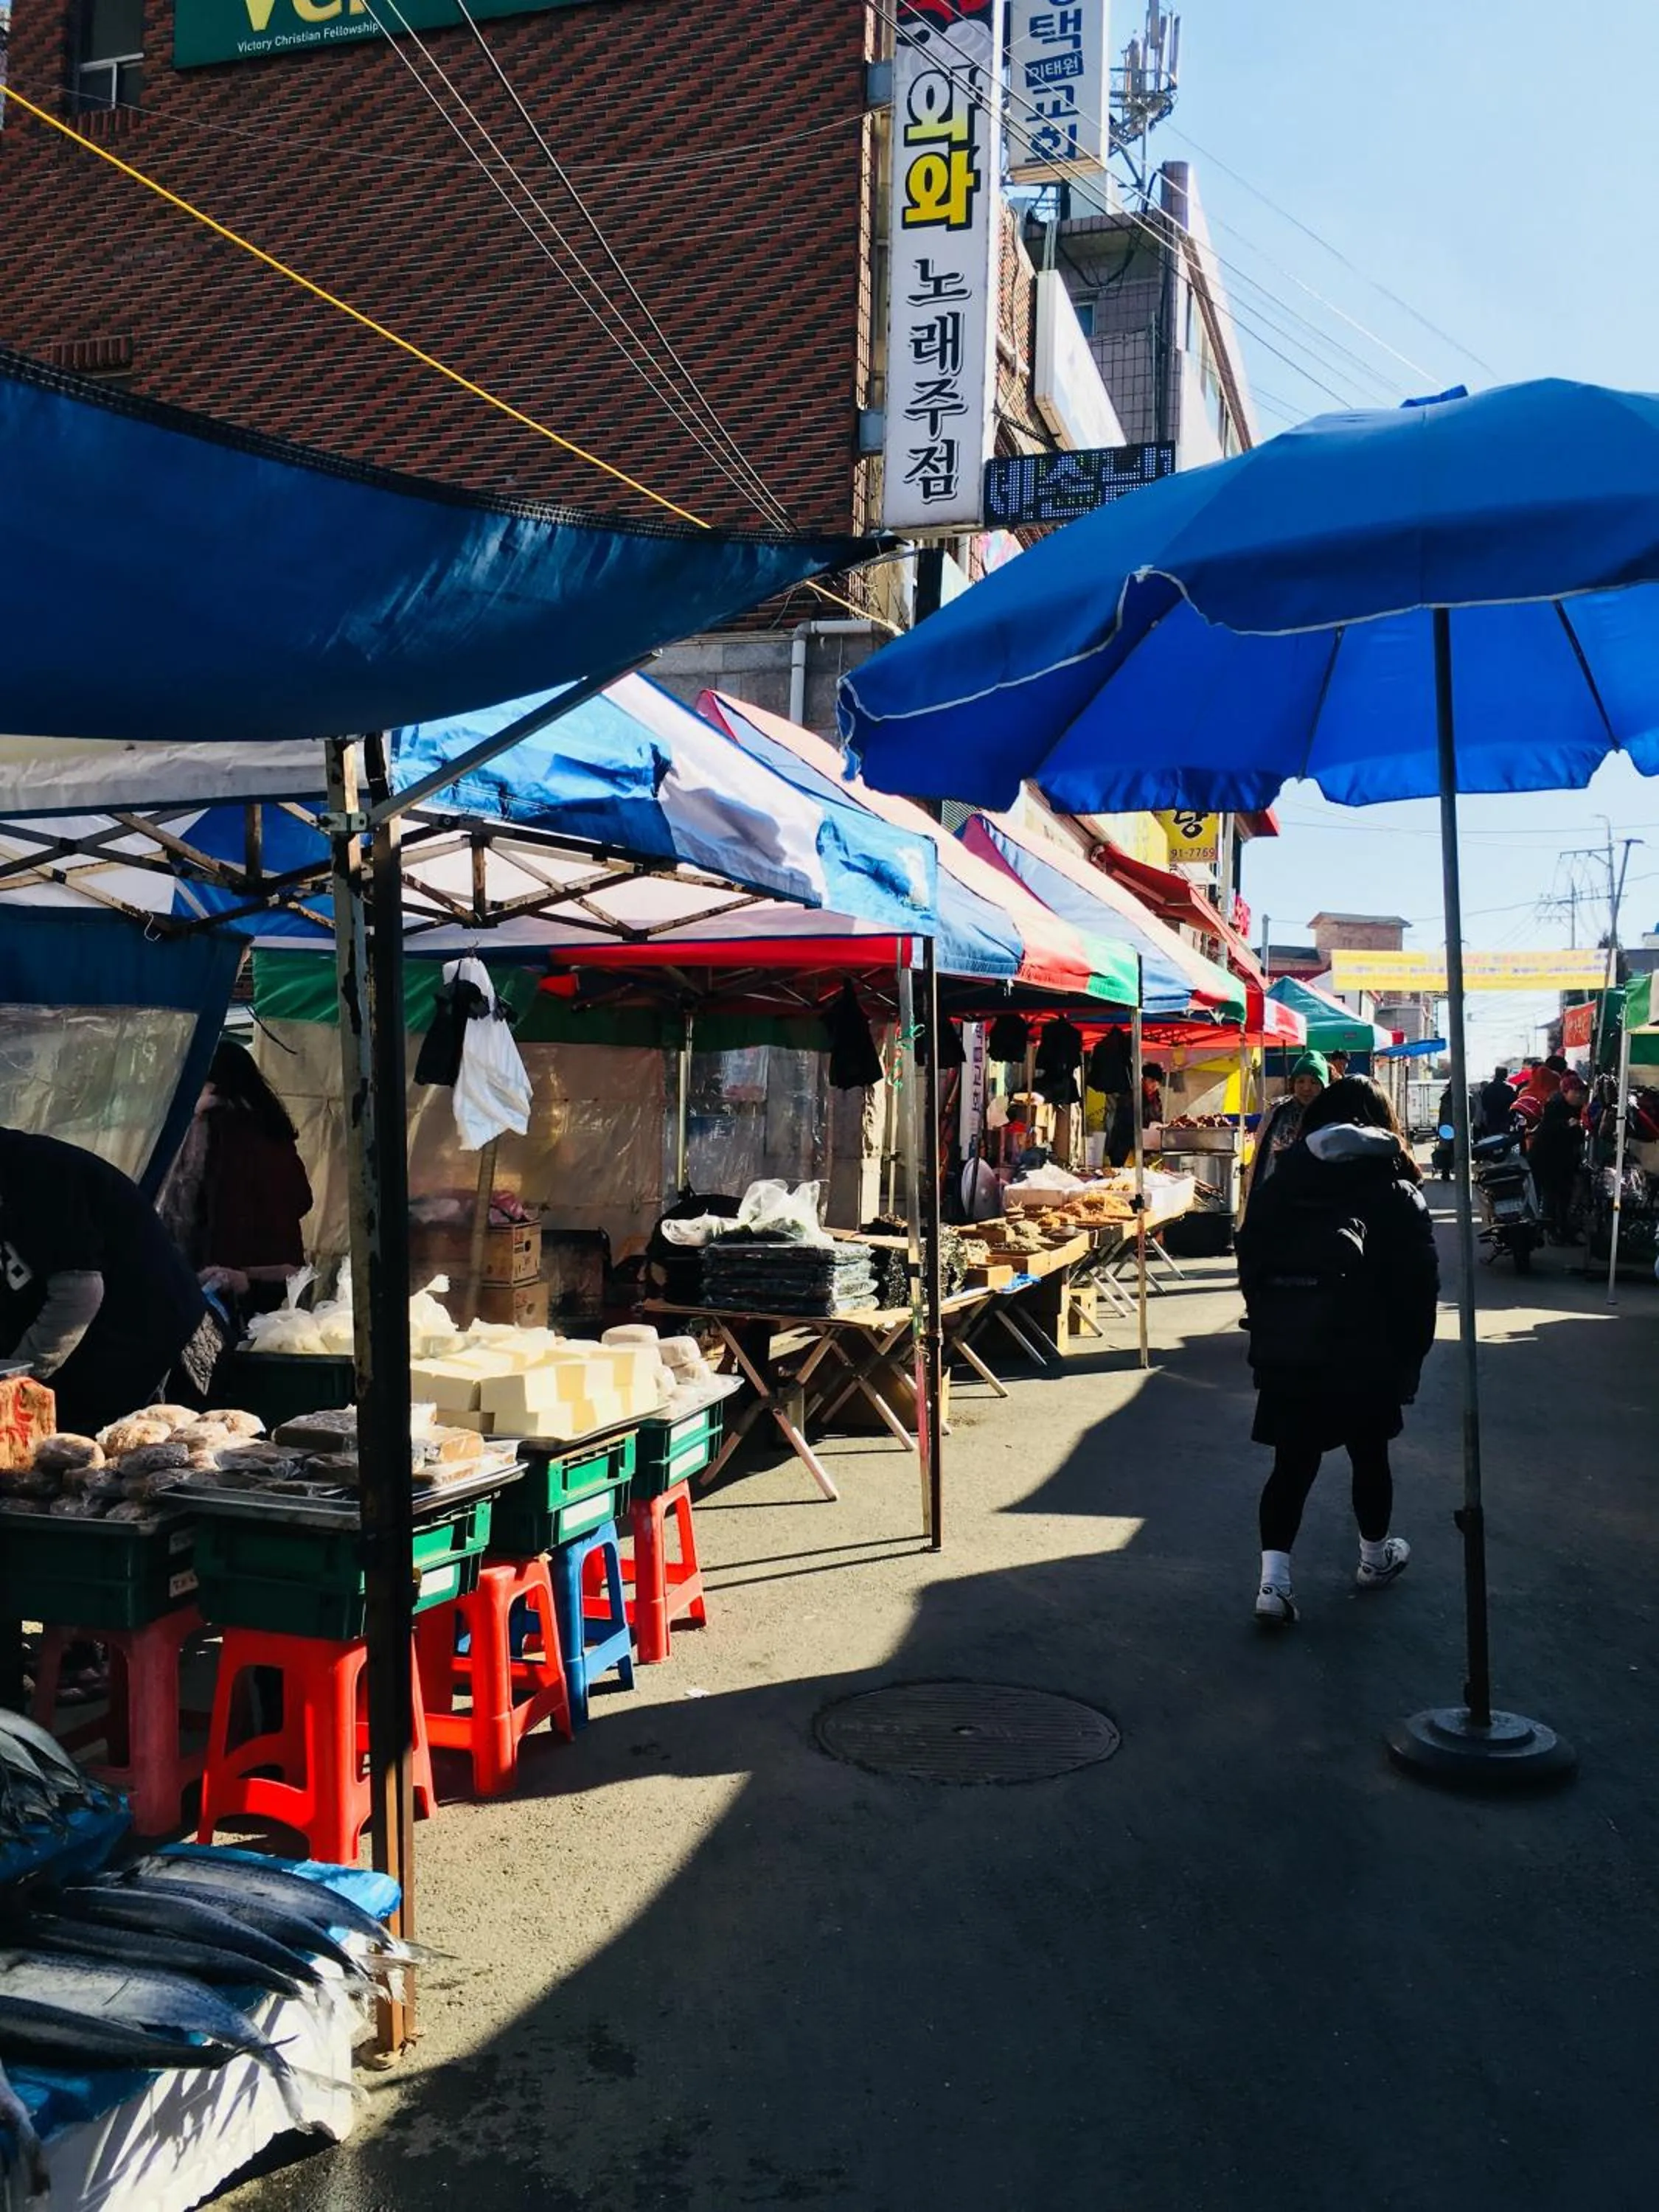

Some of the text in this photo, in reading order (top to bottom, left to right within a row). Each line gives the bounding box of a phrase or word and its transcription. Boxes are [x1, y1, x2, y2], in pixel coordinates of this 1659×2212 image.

[237, 20, 380, 53] Victory Christian Fellowship
[1030, 0, 1082, 49] 택
[903, 258, 972, 504] 노래주점
